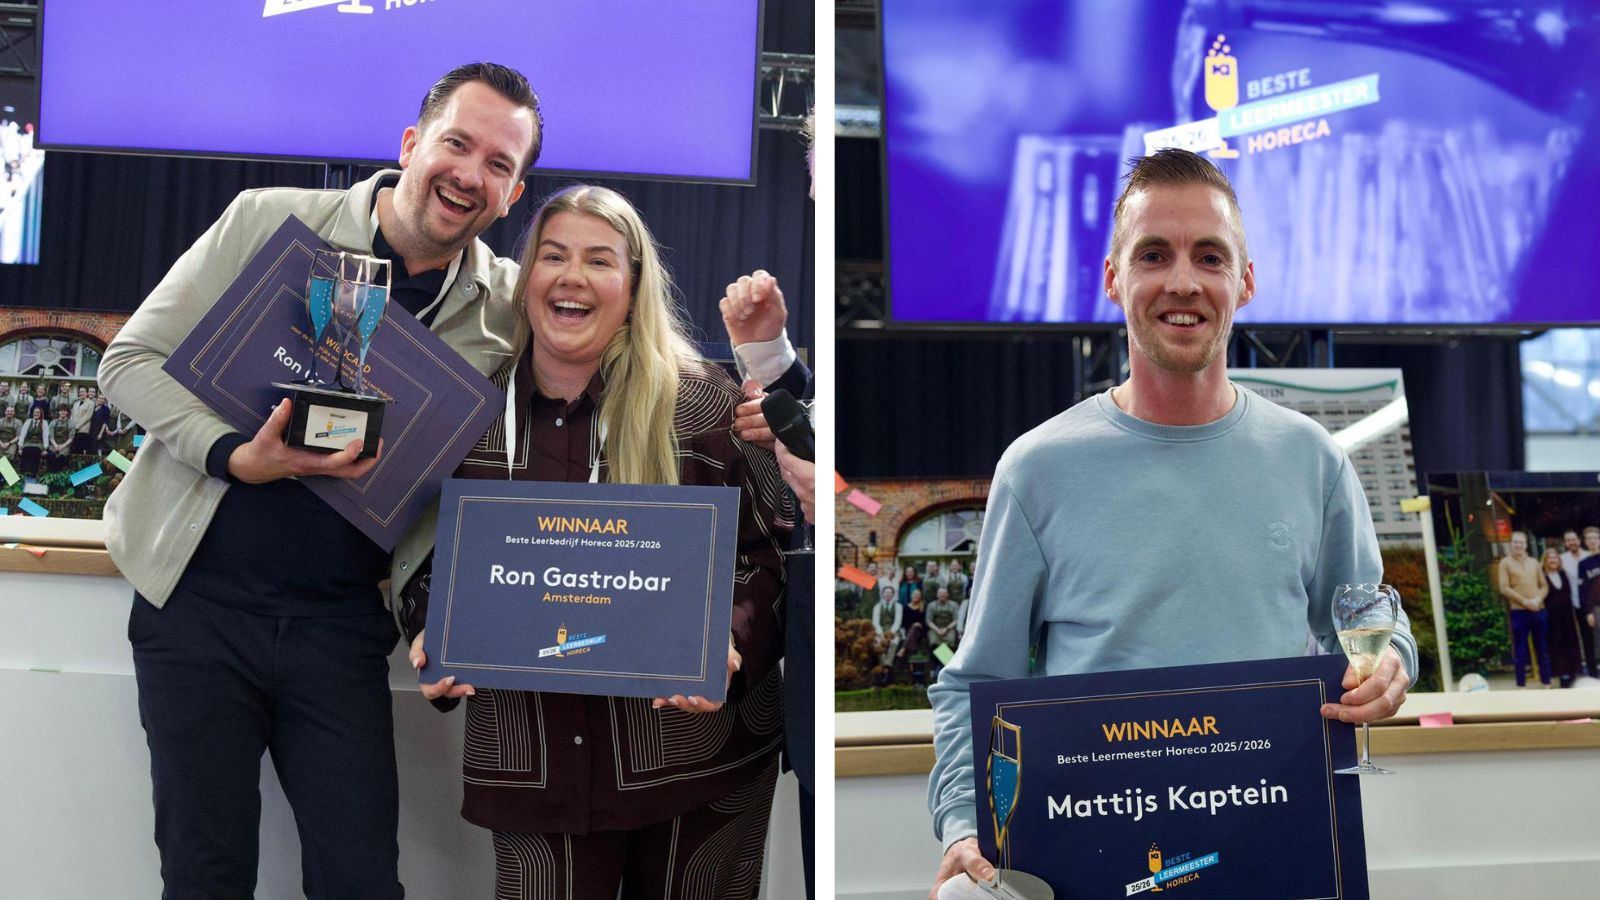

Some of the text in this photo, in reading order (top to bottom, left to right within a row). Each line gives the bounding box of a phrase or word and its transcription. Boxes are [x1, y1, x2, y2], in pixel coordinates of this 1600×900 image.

[1246, 67, 1312, 100] BESTE
[1229, 82, 1370, 131] LEERMEESTER
[1247, 118, 1331, 155] HORECA
[273, 345, 302, 374] Ron
[325, 336, 372, 374] WILCAD
[537, 516, 629, 535] WINNAAR
[505, 535, 661, 549] Beste Leerbedrijf Horeca 2025/2026
[489, 564, 671, 592] Ron Gastrobar
[542, 592, 612, 605] Amsterdam
[566, 647, 591, 656] HORECA
[1102, 715, 1220, 743] WINNAAR
[1057, 738, 1271, 765] Beste Leermeester Horeca 2025/2026
[1047, 778, 1288, 822] Mattijs Kaptein
[1159, 855, 1215, 880] LEERMEESTER
[1165, 852, 1192, 867] BESTE
[1131, 880, 1151, 892] 25/26
[1166, 872, 1200, 889] HORECA
